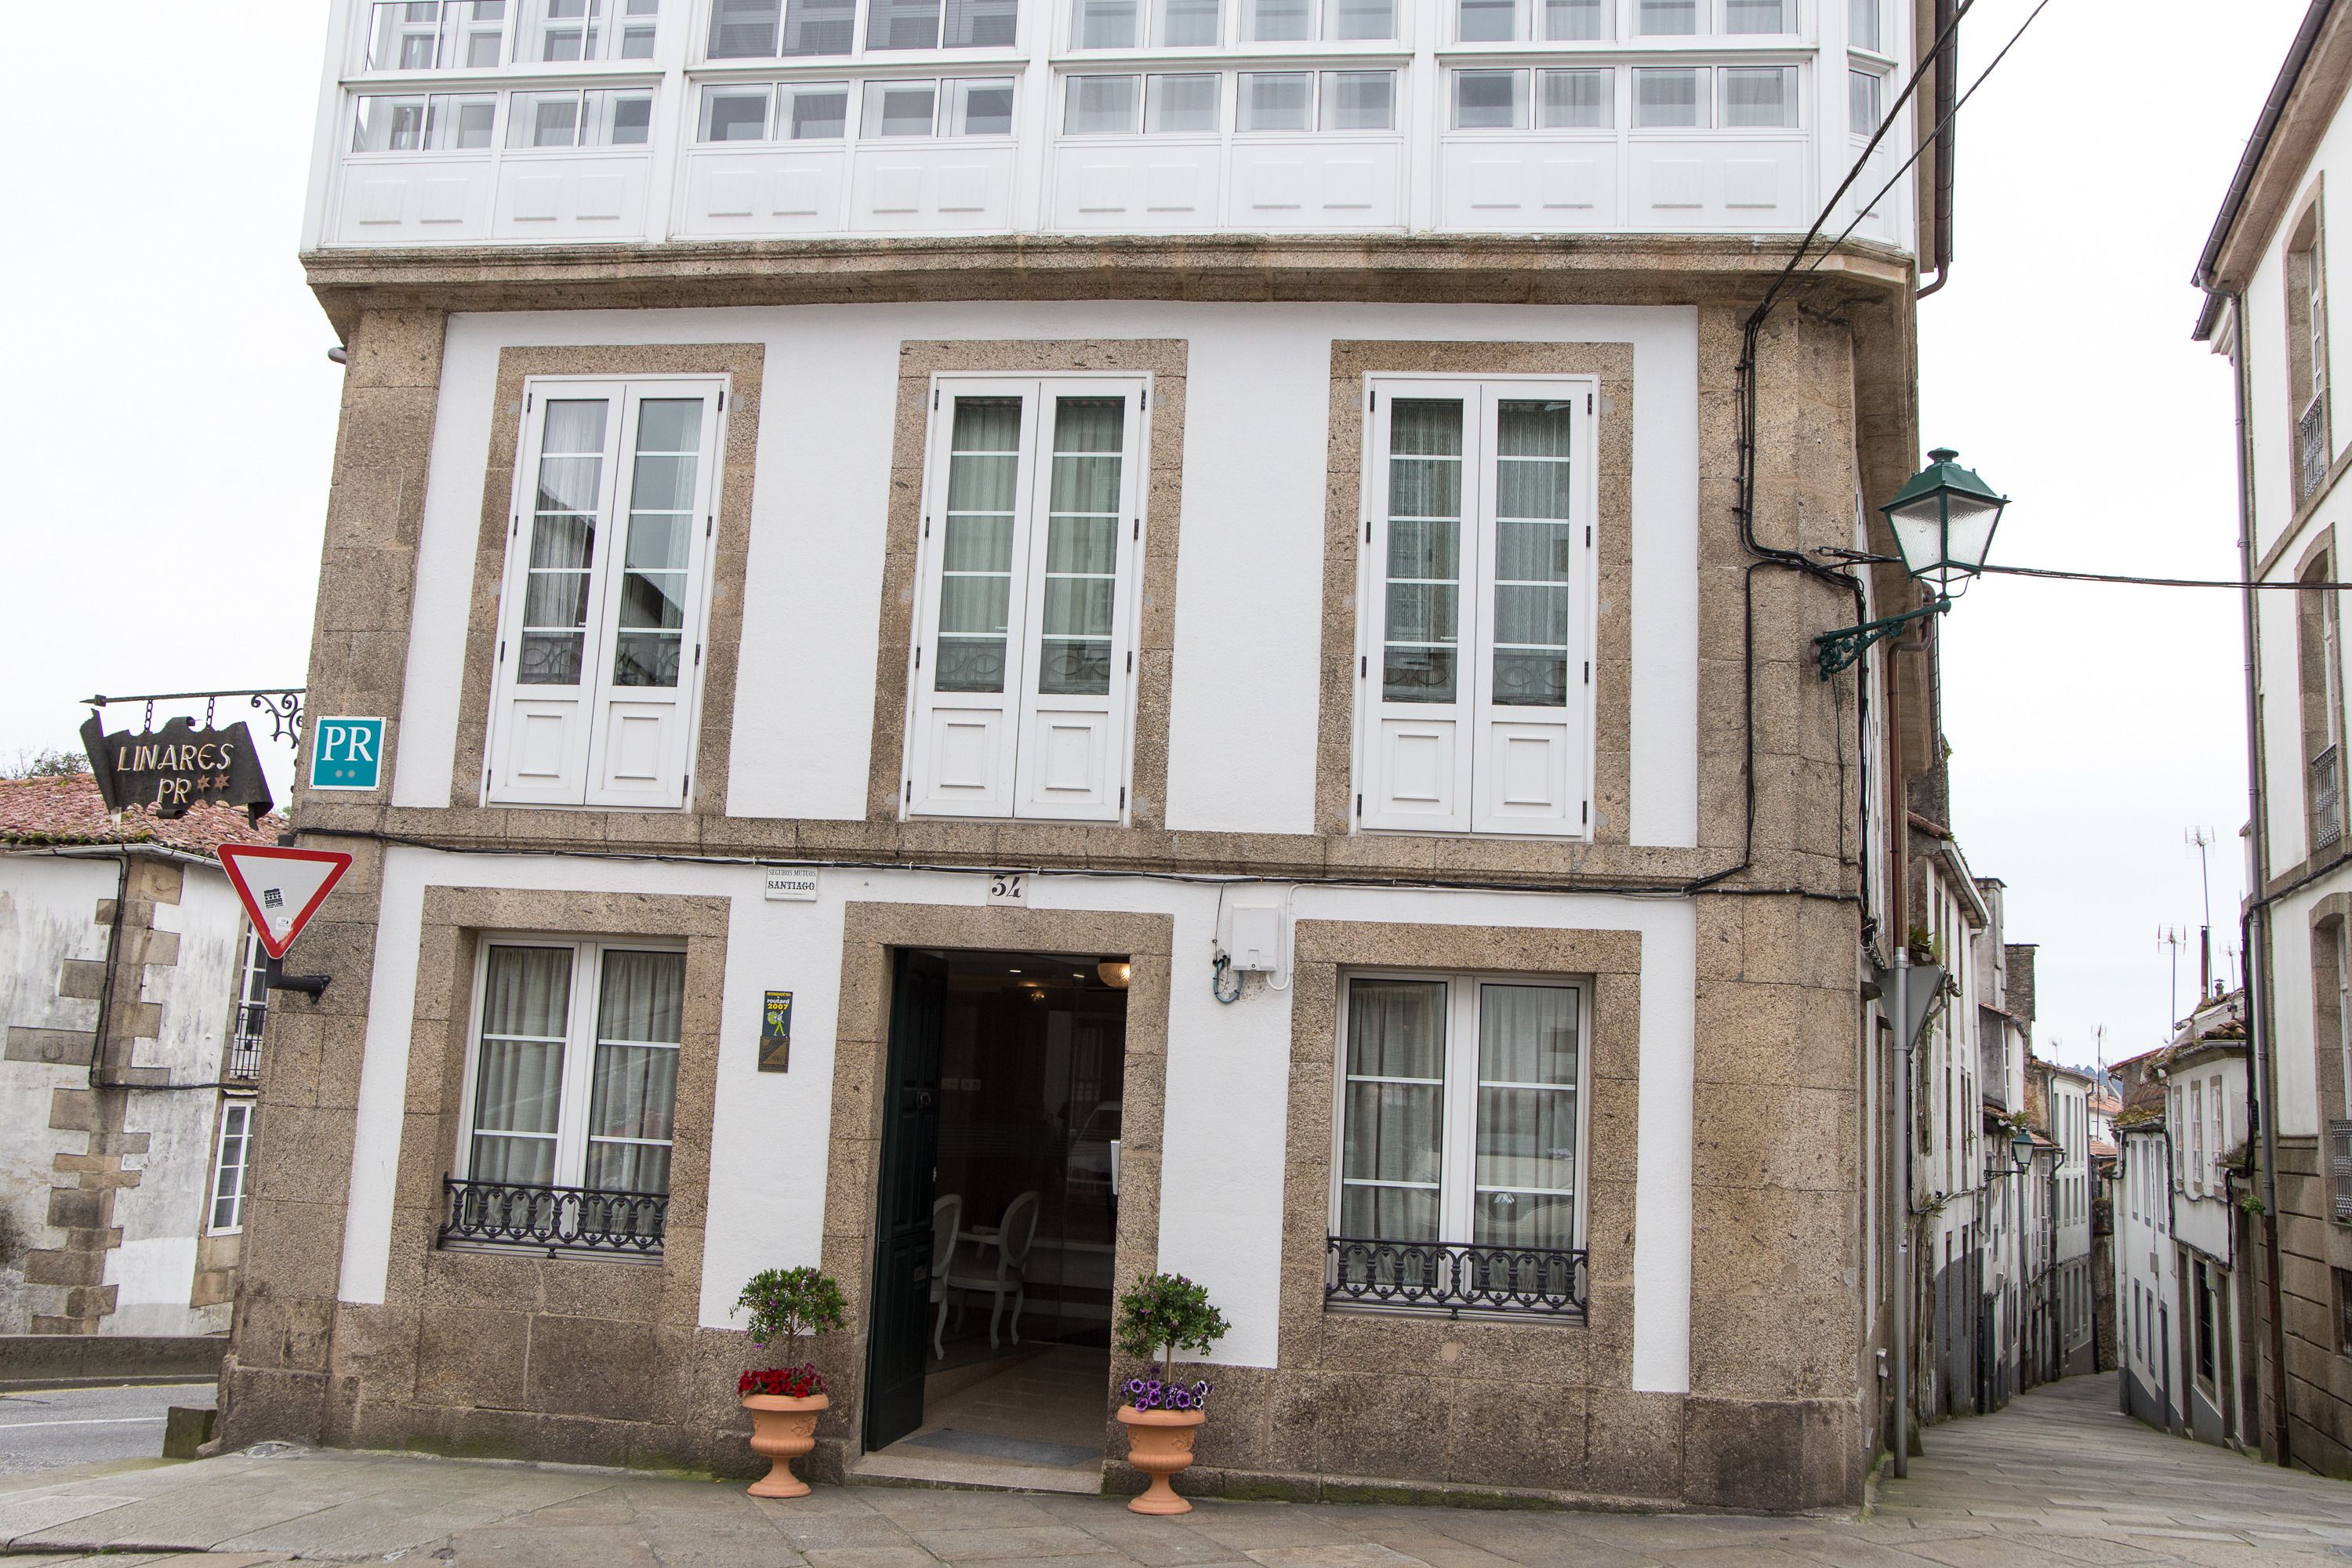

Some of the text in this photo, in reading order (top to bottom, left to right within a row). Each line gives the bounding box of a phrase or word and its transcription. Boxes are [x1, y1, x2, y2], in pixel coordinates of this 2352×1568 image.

[118, 743, 234, 771] LINARES
[321, 726, 374, 761] PR
[157, 777, 192, 804] PR
[991, 874, 1022, 898] 34
